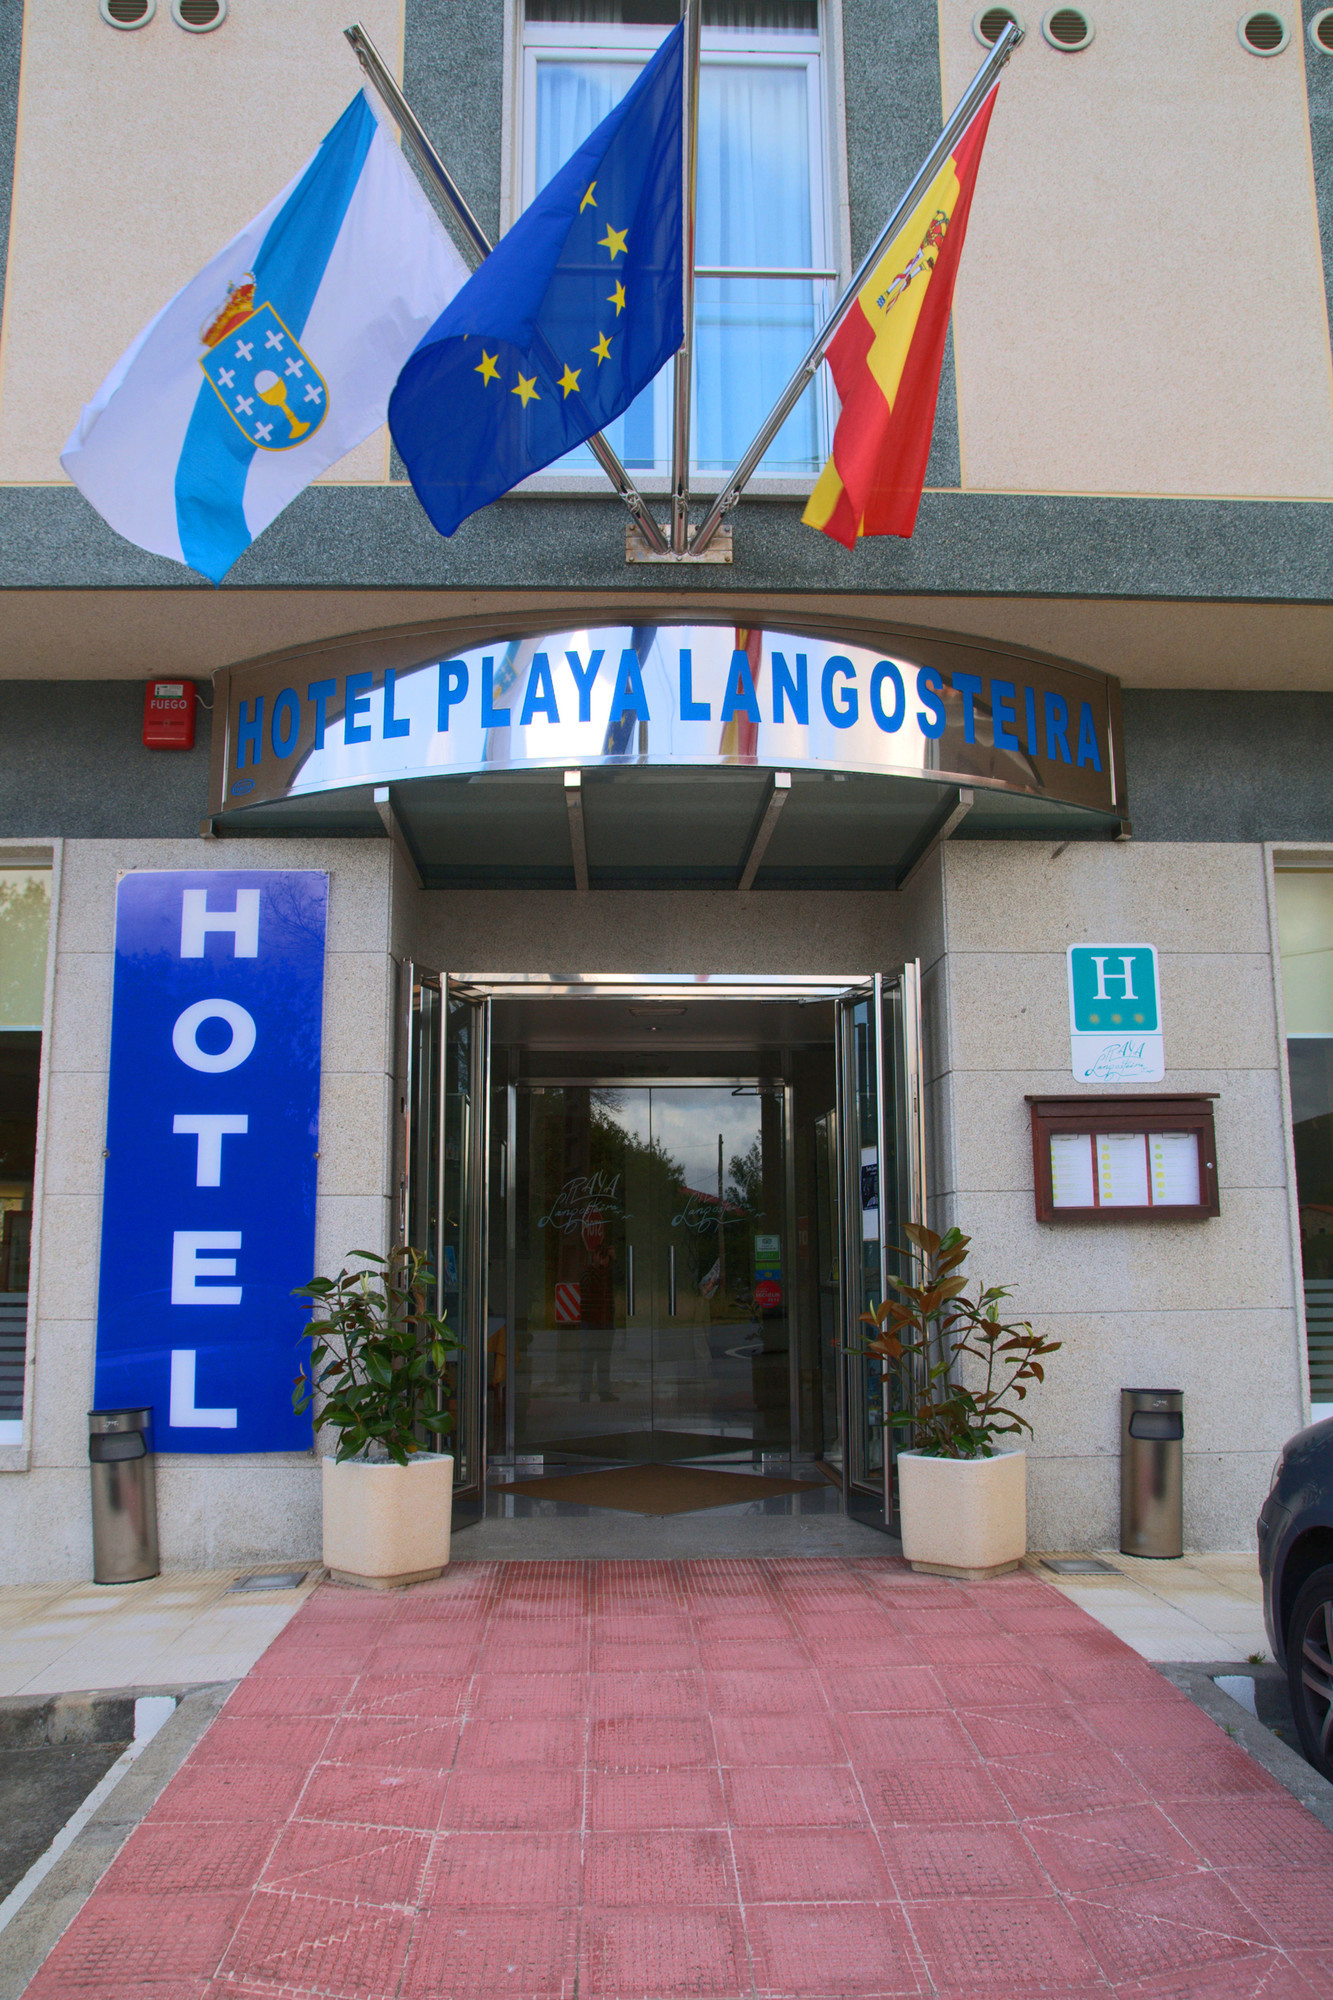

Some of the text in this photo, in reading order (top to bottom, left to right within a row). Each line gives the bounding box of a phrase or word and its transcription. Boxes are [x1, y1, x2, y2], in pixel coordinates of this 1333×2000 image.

[150, 699, 187, 709] FUEGO
[237, 649, 1102, 772] HOTEL PLAYA LANGOSTEIRA
[1090, 956, 1139, 999] H
[169, 889, 261, 1429] HOTEL
